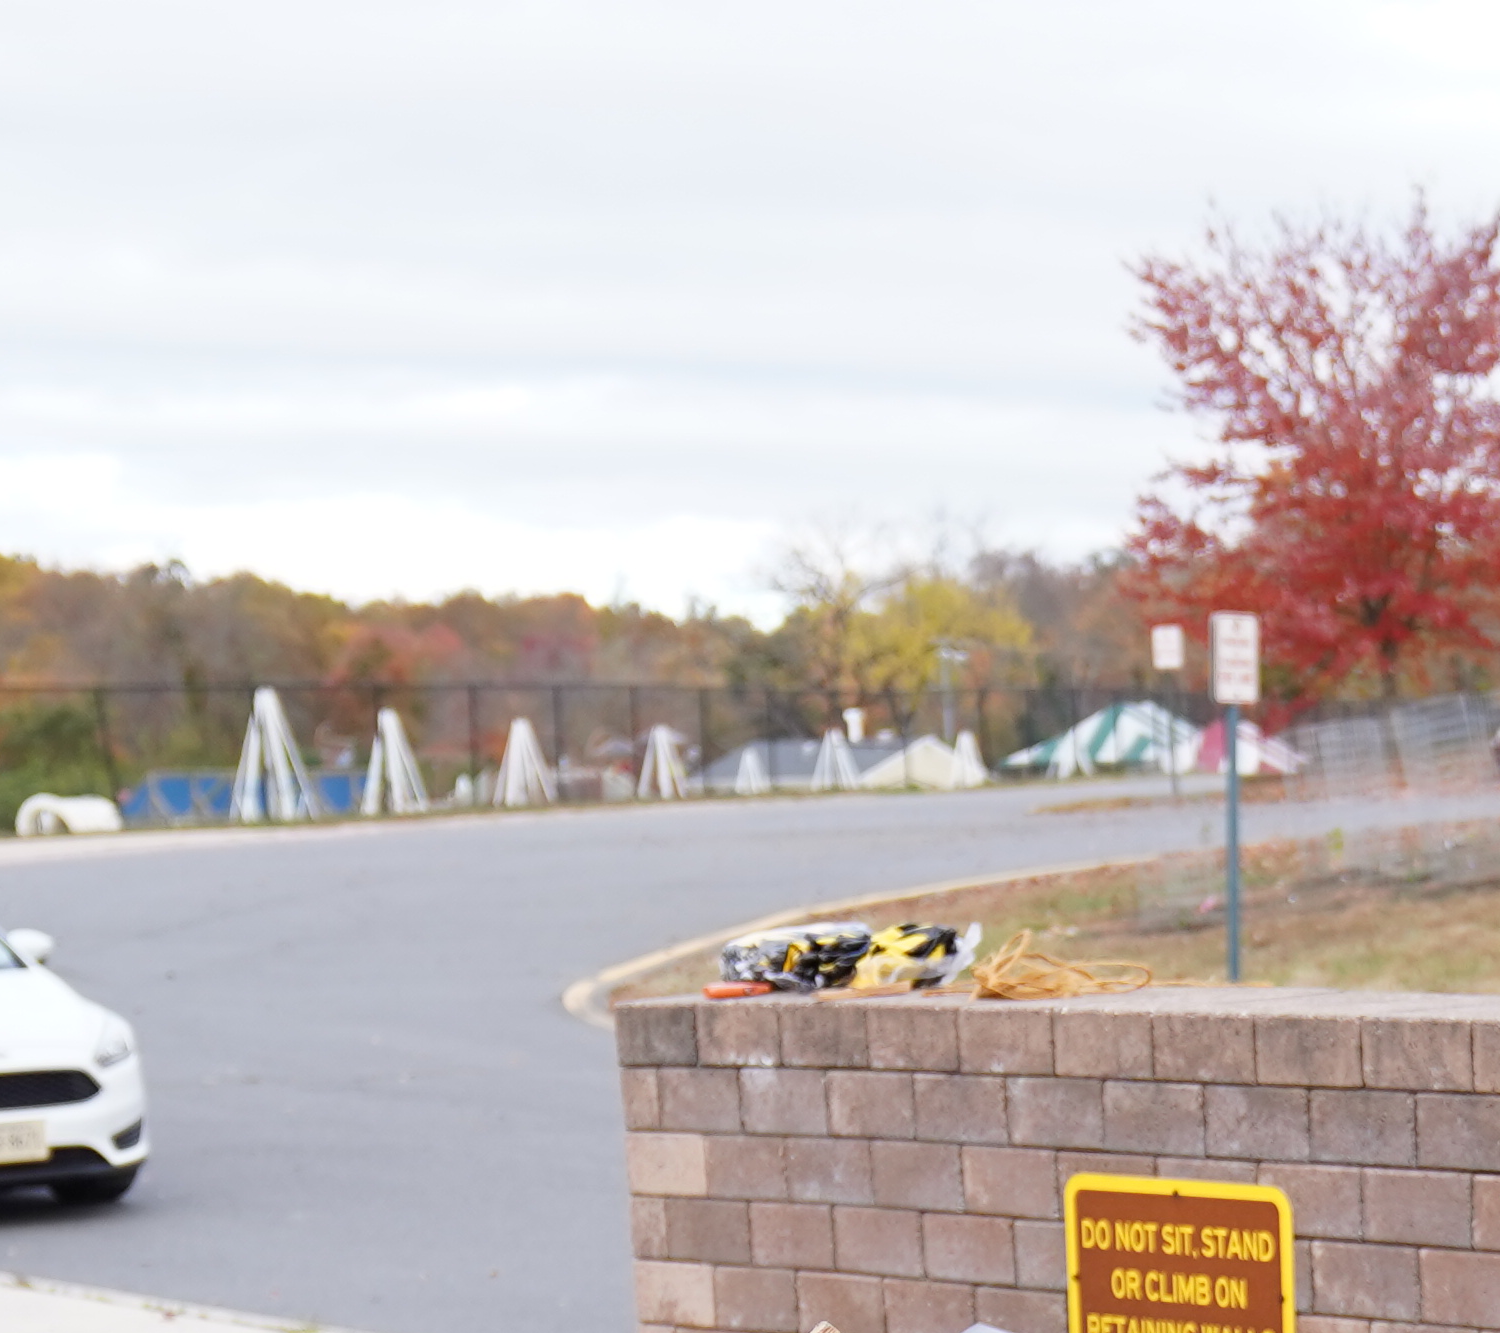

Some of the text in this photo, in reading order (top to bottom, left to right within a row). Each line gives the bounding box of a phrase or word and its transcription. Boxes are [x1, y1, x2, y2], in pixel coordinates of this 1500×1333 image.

[1081, 1218, 1276, 1262] DO NOT SIT, STAND
[1111, 1267, 1248, 1309] OR CLIMB ON
